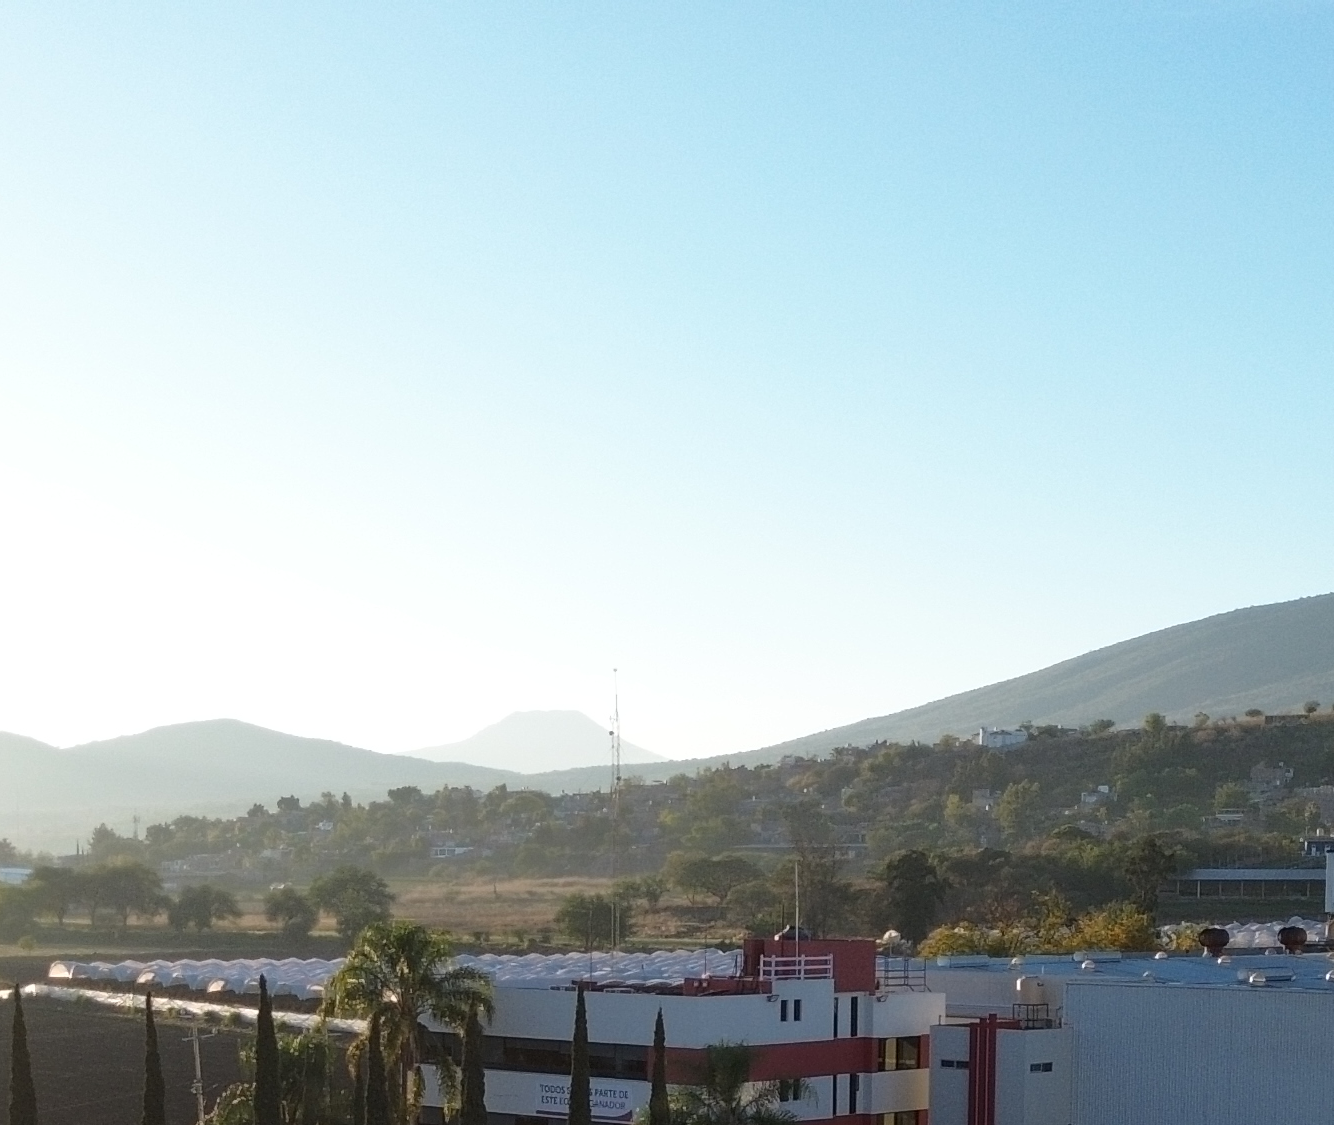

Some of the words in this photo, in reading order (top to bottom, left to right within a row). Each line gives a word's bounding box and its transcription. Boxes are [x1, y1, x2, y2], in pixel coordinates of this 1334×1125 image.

[539, 1083, 565, 1095] TODOS
[594, 1088, 617, 1099] PARTE
[618, 1090, 629, 1099] DE
[540, 1095, 558, 1105] ESTE
